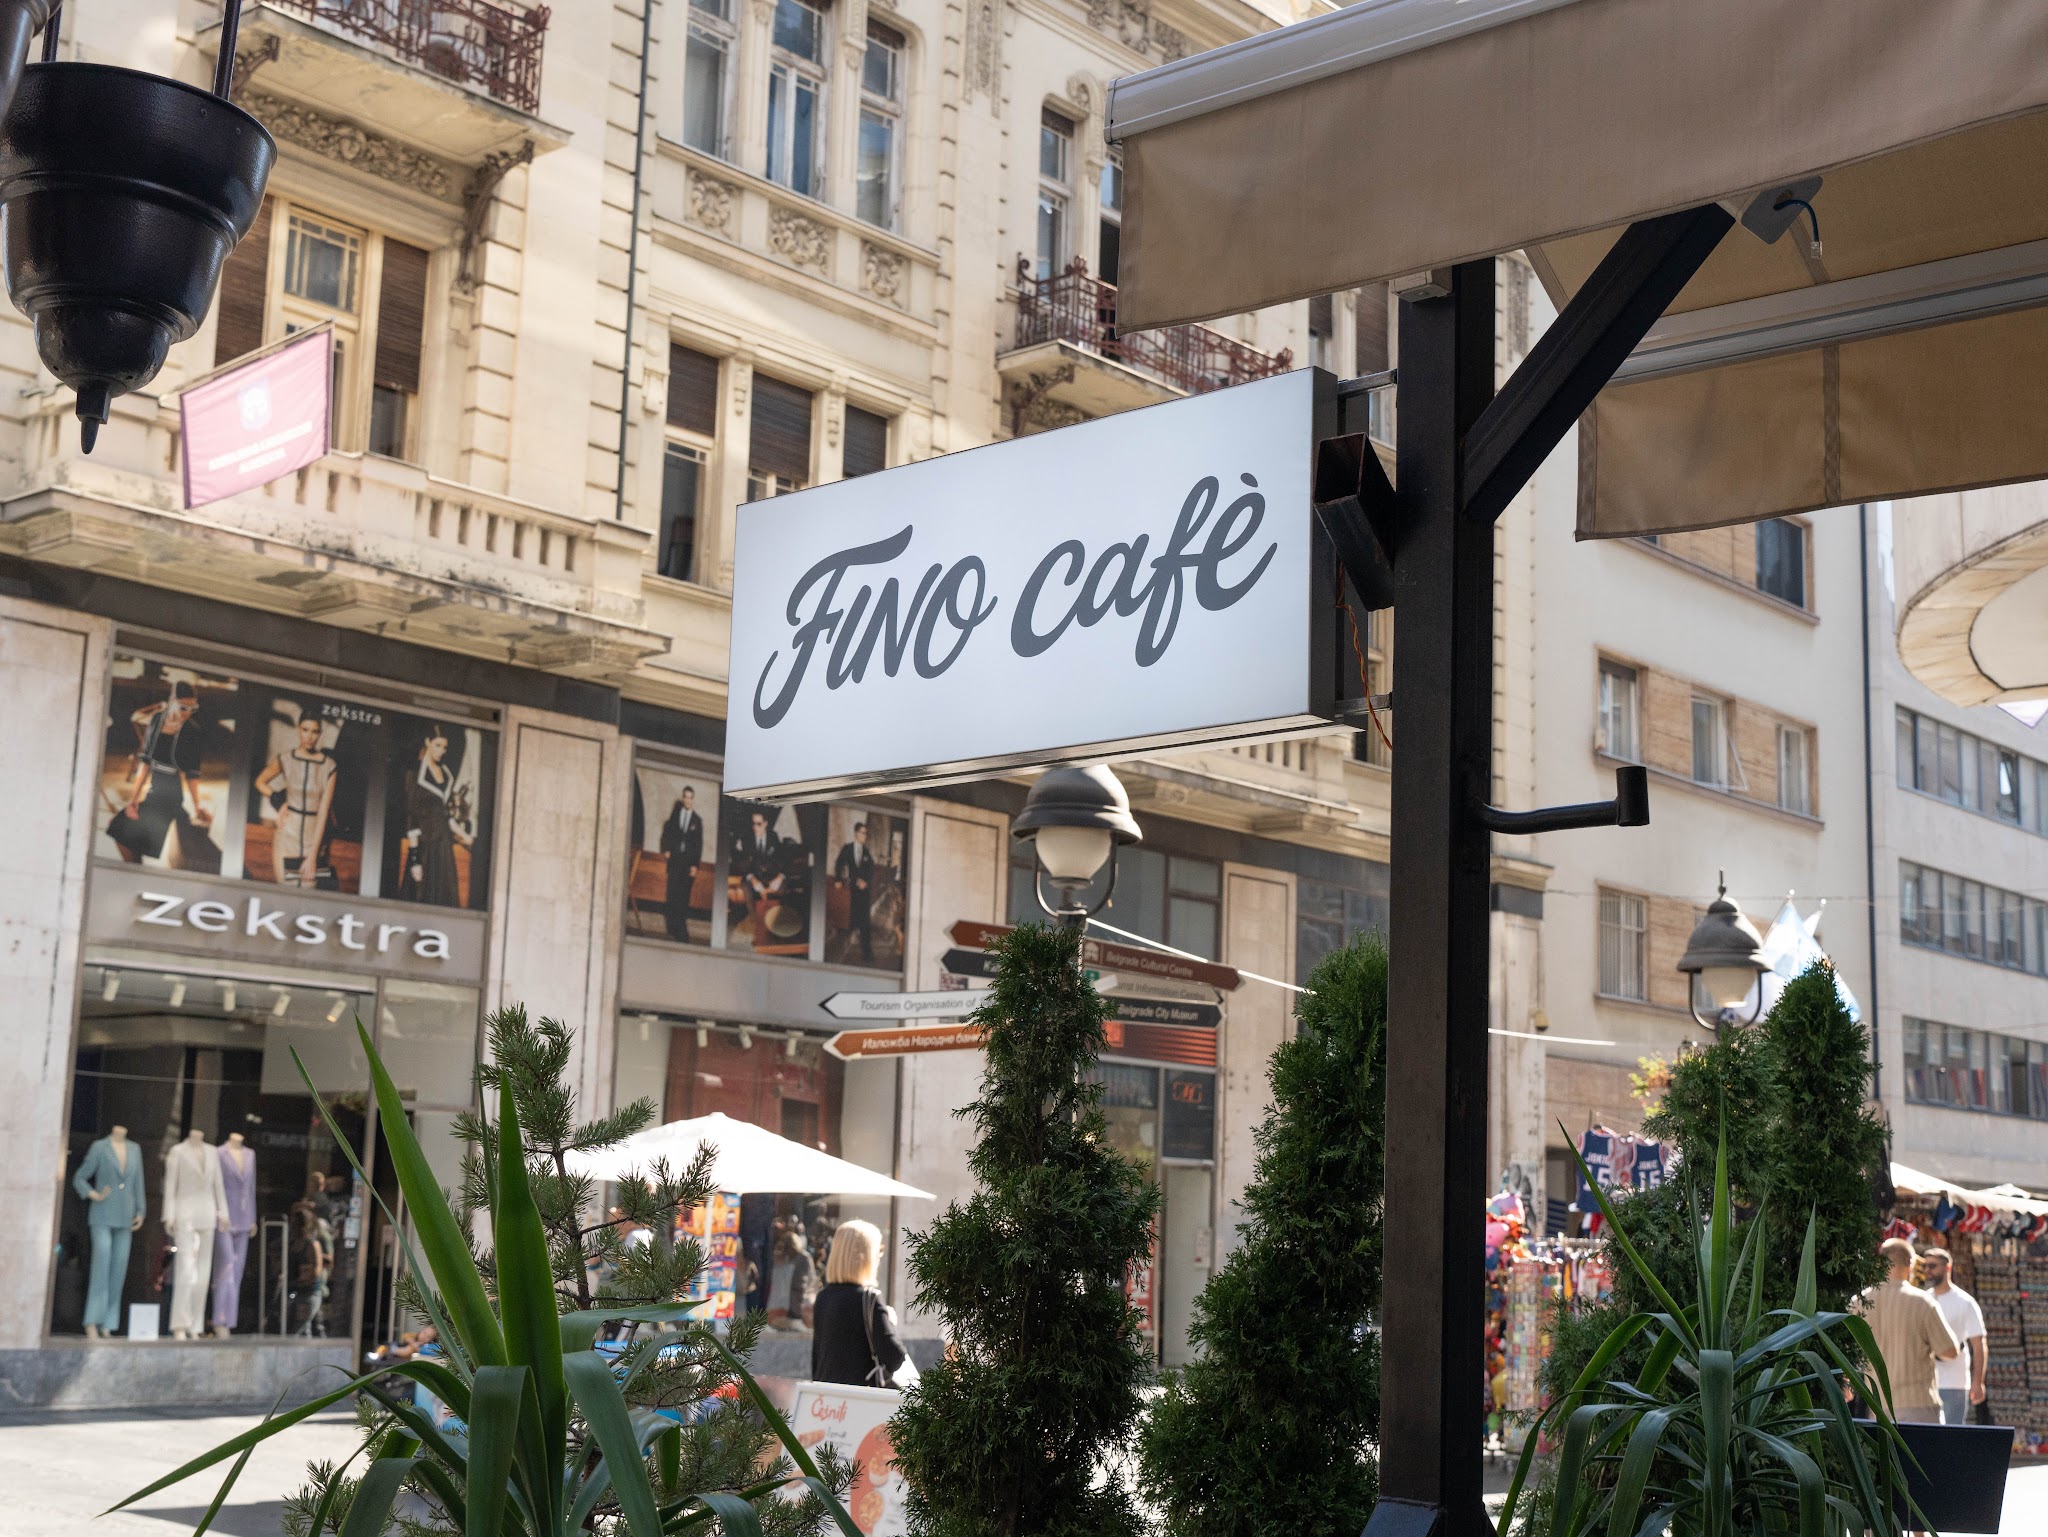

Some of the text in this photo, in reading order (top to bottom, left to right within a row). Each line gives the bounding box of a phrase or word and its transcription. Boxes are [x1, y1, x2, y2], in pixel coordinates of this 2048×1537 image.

[322, 702, 383, 726] zekstra
[137, 891, 451, 961] zekstra
[1106, 951, 1139, 965] Belgrade
[1140, 957, 1169, 973] Cultural
[860, 1000, 900, 1011] Tourism
[904, 999, 963, 1013] Organisation
[965, 998, 977, 1008] of
[1118, 1004, 1199, 1021] Belgrade City Museum
